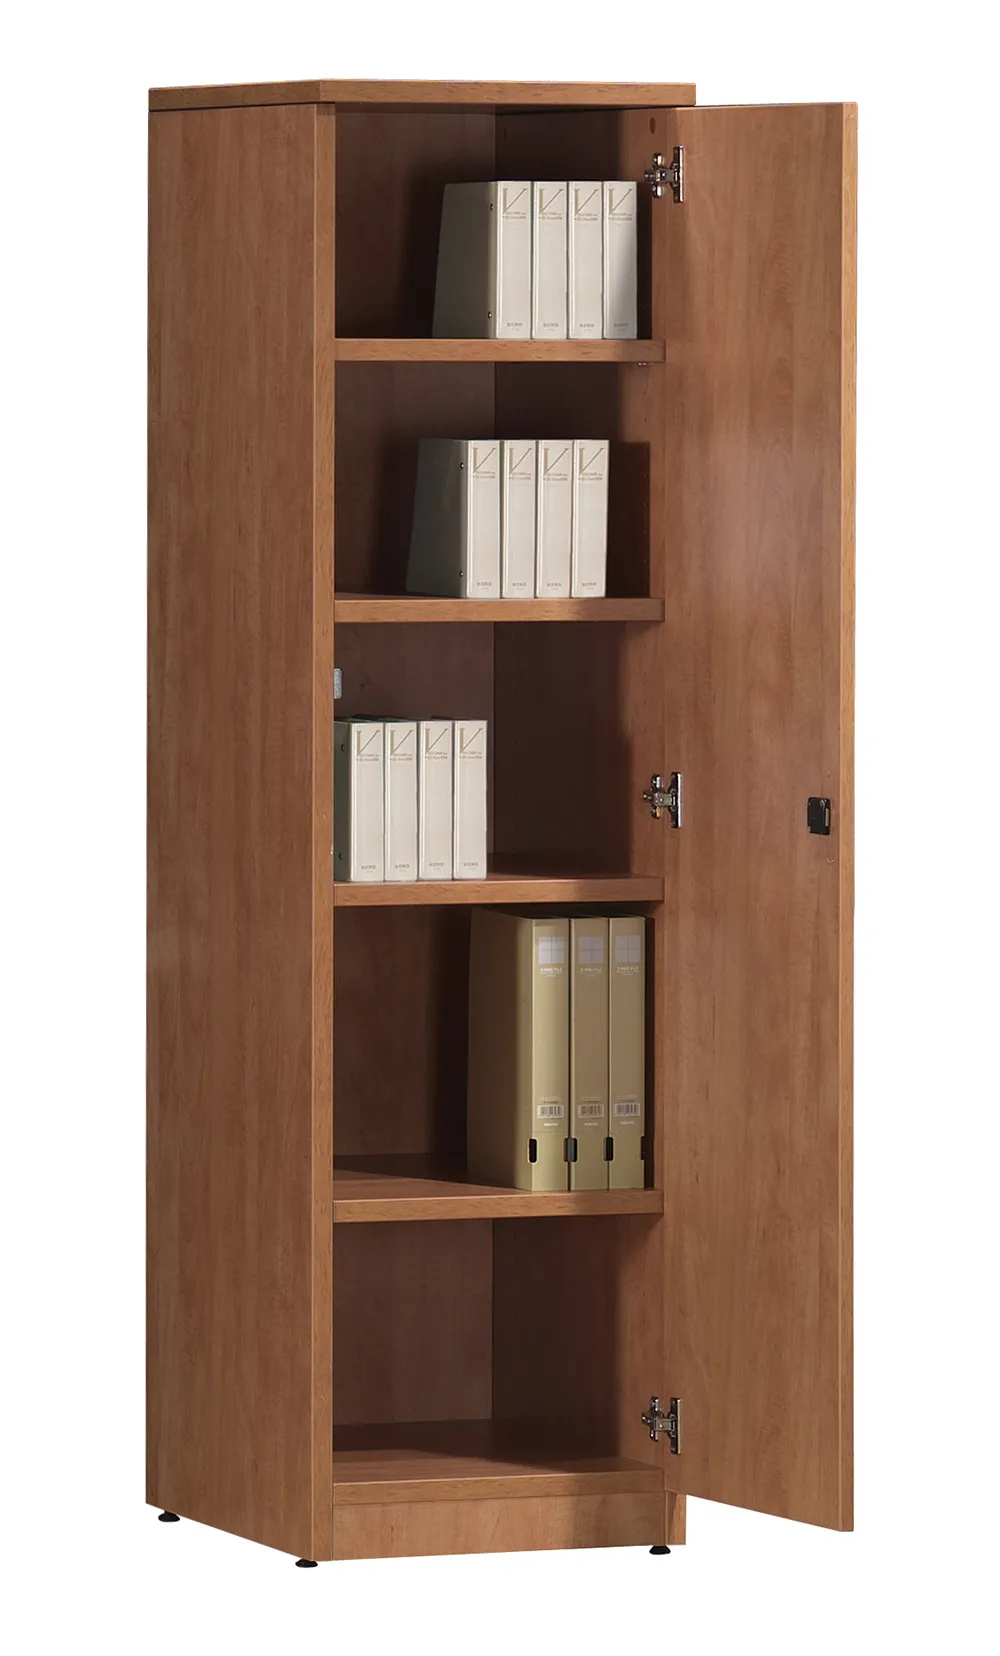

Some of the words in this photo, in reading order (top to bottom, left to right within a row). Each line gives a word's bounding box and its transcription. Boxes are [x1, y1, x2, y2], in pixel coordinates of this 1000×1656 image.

[503, 188, 527, 214] V
[539, 189, 564, 214] V
[574, 189, 599, 215] V
[608, 189, 633, 215] V
[473, 447, 496, 473] V
[509, 448, 533, 474] V
[543, 448, 569, 475] V
[578, 447, 604, 474] V
[356, 729, 380, 756] V
[389, 729, 414, 756] V
[424, 728, 448, 754] V
[459, 728, 483, 753] V
